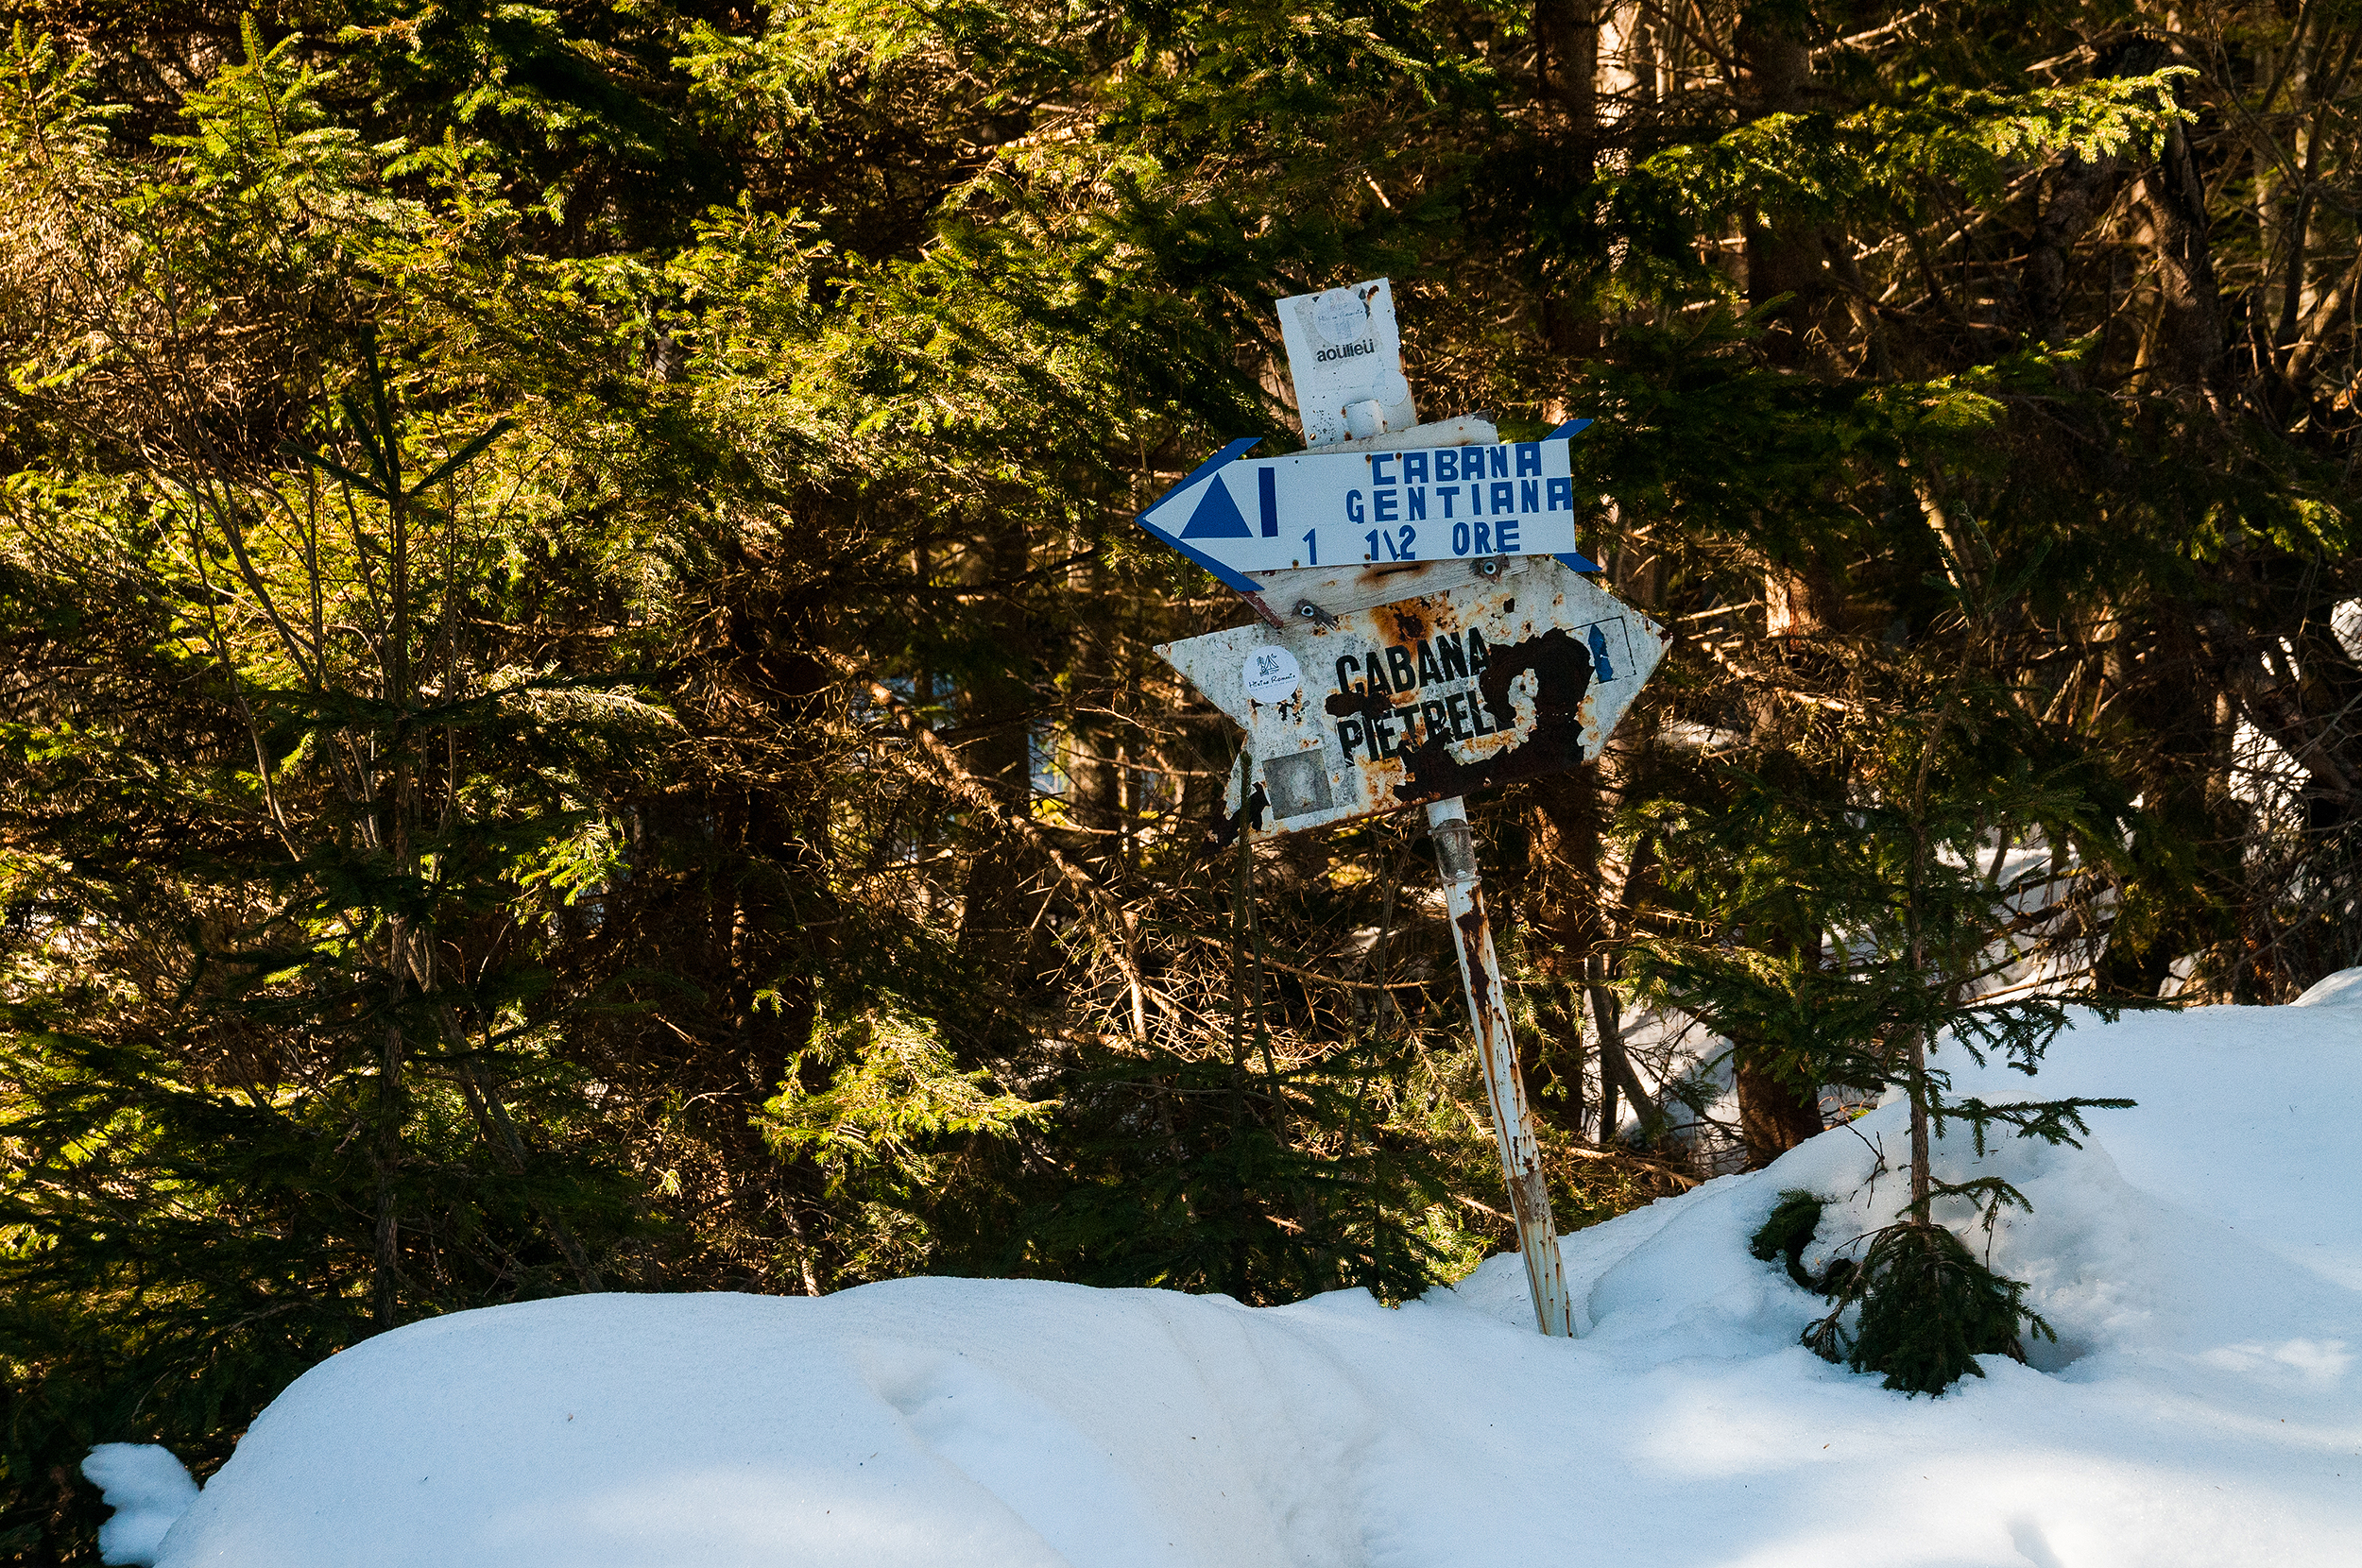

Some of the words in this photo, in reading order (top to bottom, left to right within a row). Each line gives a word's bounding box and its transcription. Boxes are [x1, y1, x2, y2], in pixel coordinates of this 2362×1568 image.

[1372, 442, 1542, 486] CABANA
[1345, 476, 1572, 524] GENTIANA
[1302, 527, 1317, 565] 1
[1452, 520, 1520, 556] ORE
[1335, 626, 1491, 696] CABANA
[1336, 690, 1516, 768] PIETREL
